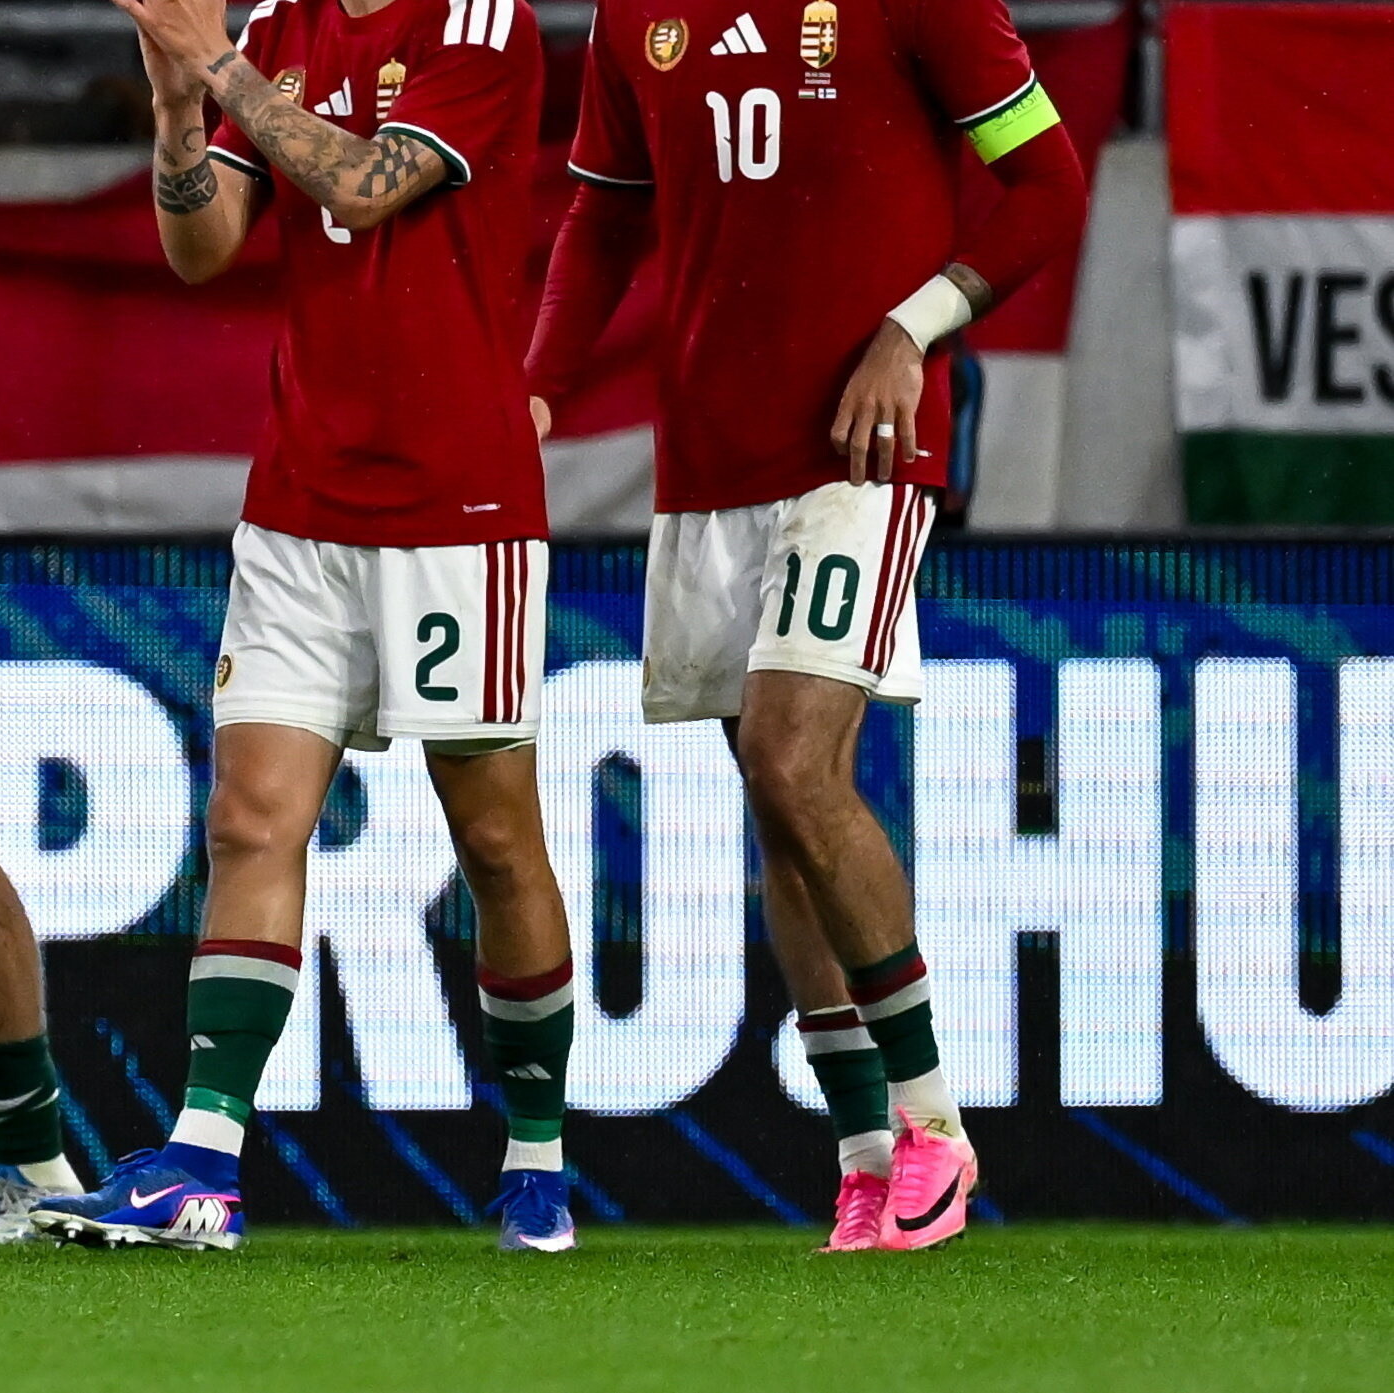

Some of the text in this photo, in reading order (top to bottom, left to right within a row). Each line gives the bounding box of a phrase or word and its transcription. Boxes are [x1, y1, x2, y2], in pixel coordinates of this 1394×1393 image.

[704, 87, 781, 183] 10
[775, 551, 860, 642] 10
[415, 612, 460, 702] 2
